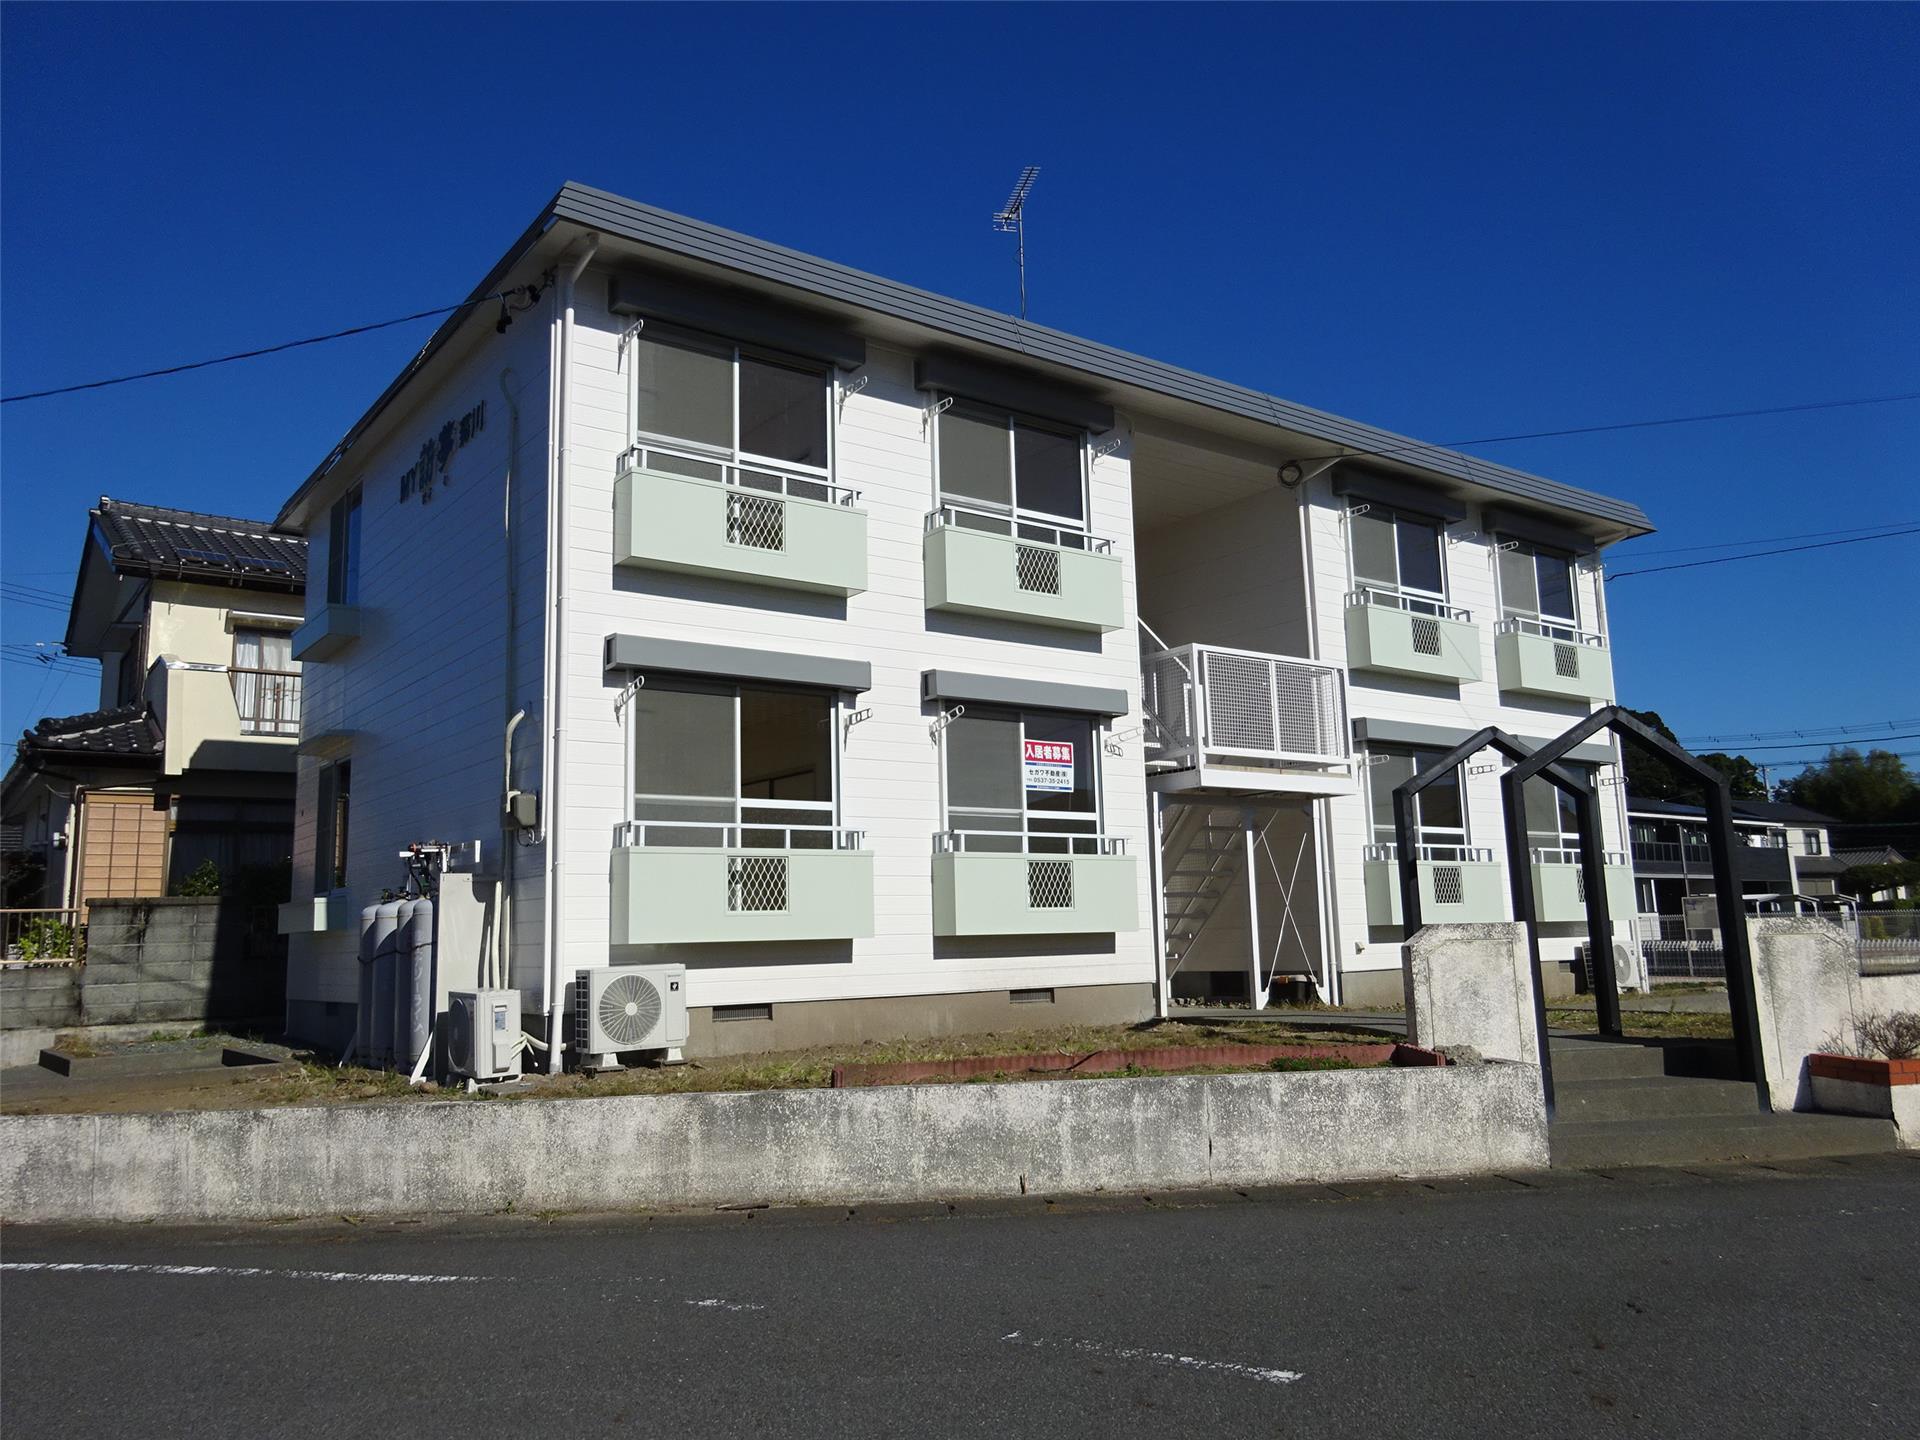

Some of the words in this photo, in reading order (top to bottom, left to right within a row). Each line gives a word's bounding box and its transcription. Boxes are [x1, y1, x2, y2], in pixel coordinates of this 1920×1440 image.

[1026, 744, 1070, 760] 入居者募集
